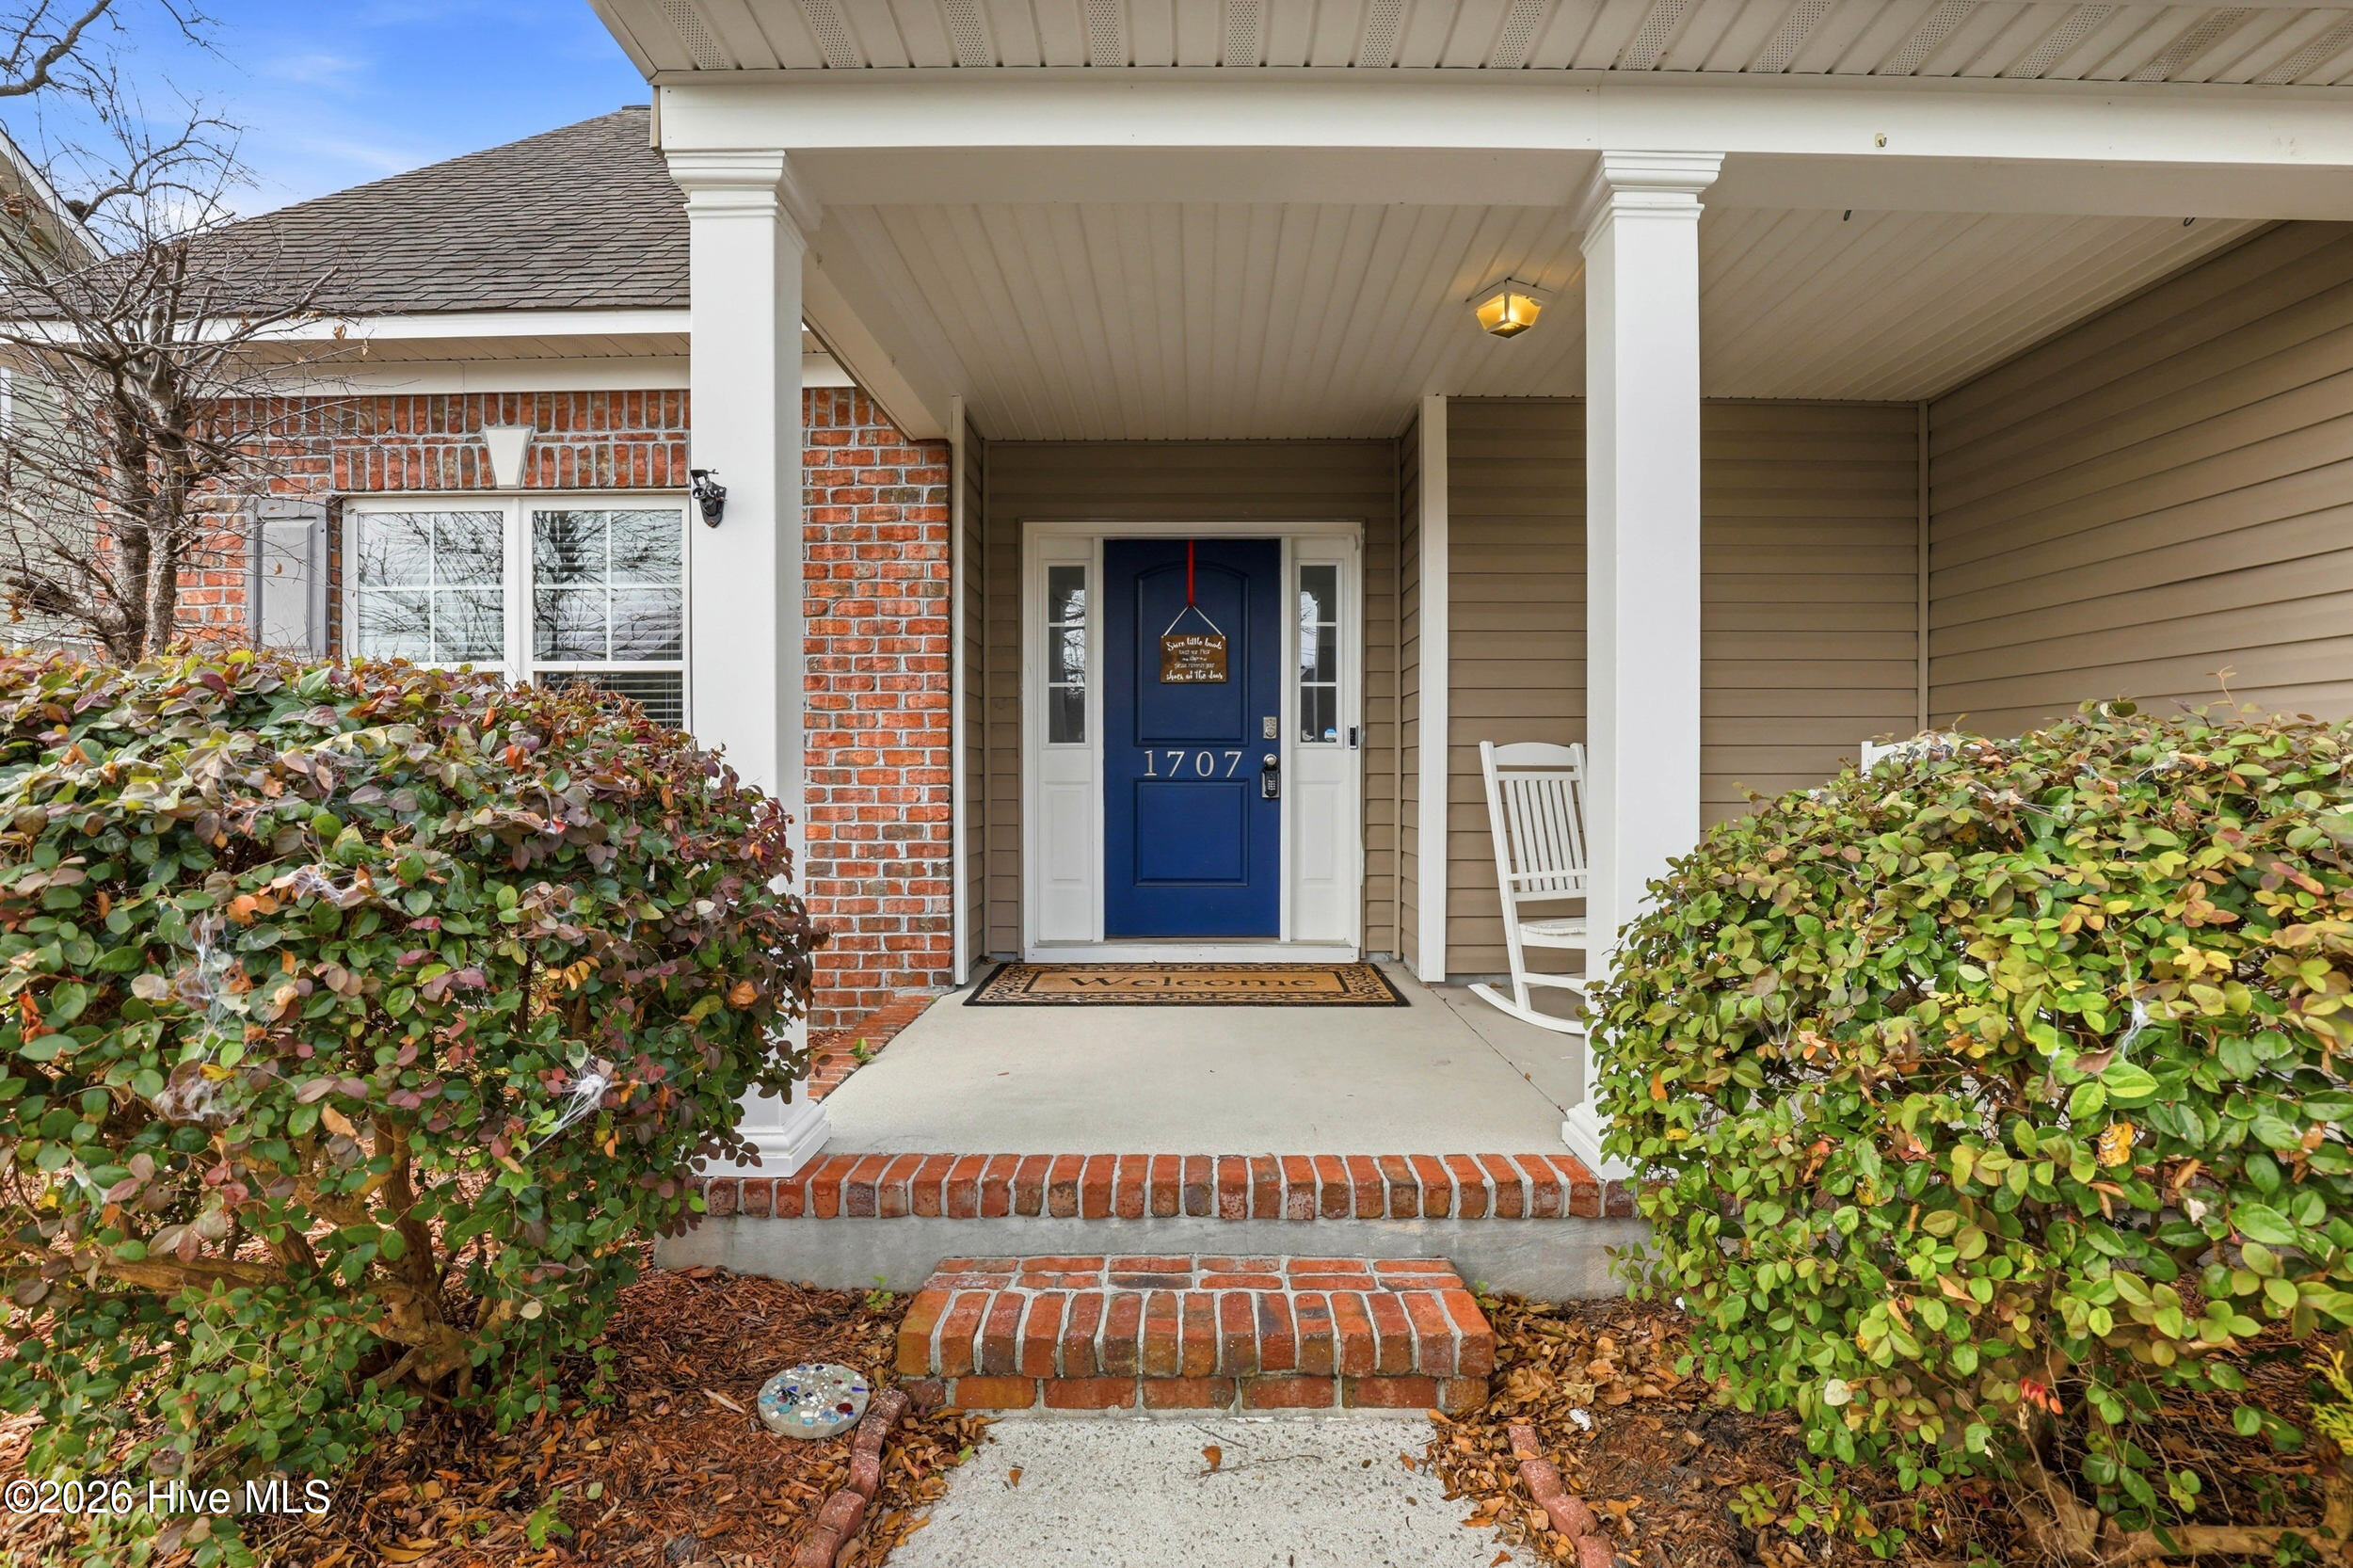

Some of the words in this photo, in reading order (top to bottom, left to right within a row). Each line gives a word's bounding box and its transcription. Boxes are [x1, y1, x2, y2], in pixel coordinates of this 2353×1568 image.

[1187, 637, 1203, 646] little
[1186, 670, 1193, 680] at
[1144, 750, 1242, 777] 1707
[1068, 976, 1317, 987] Welcome
